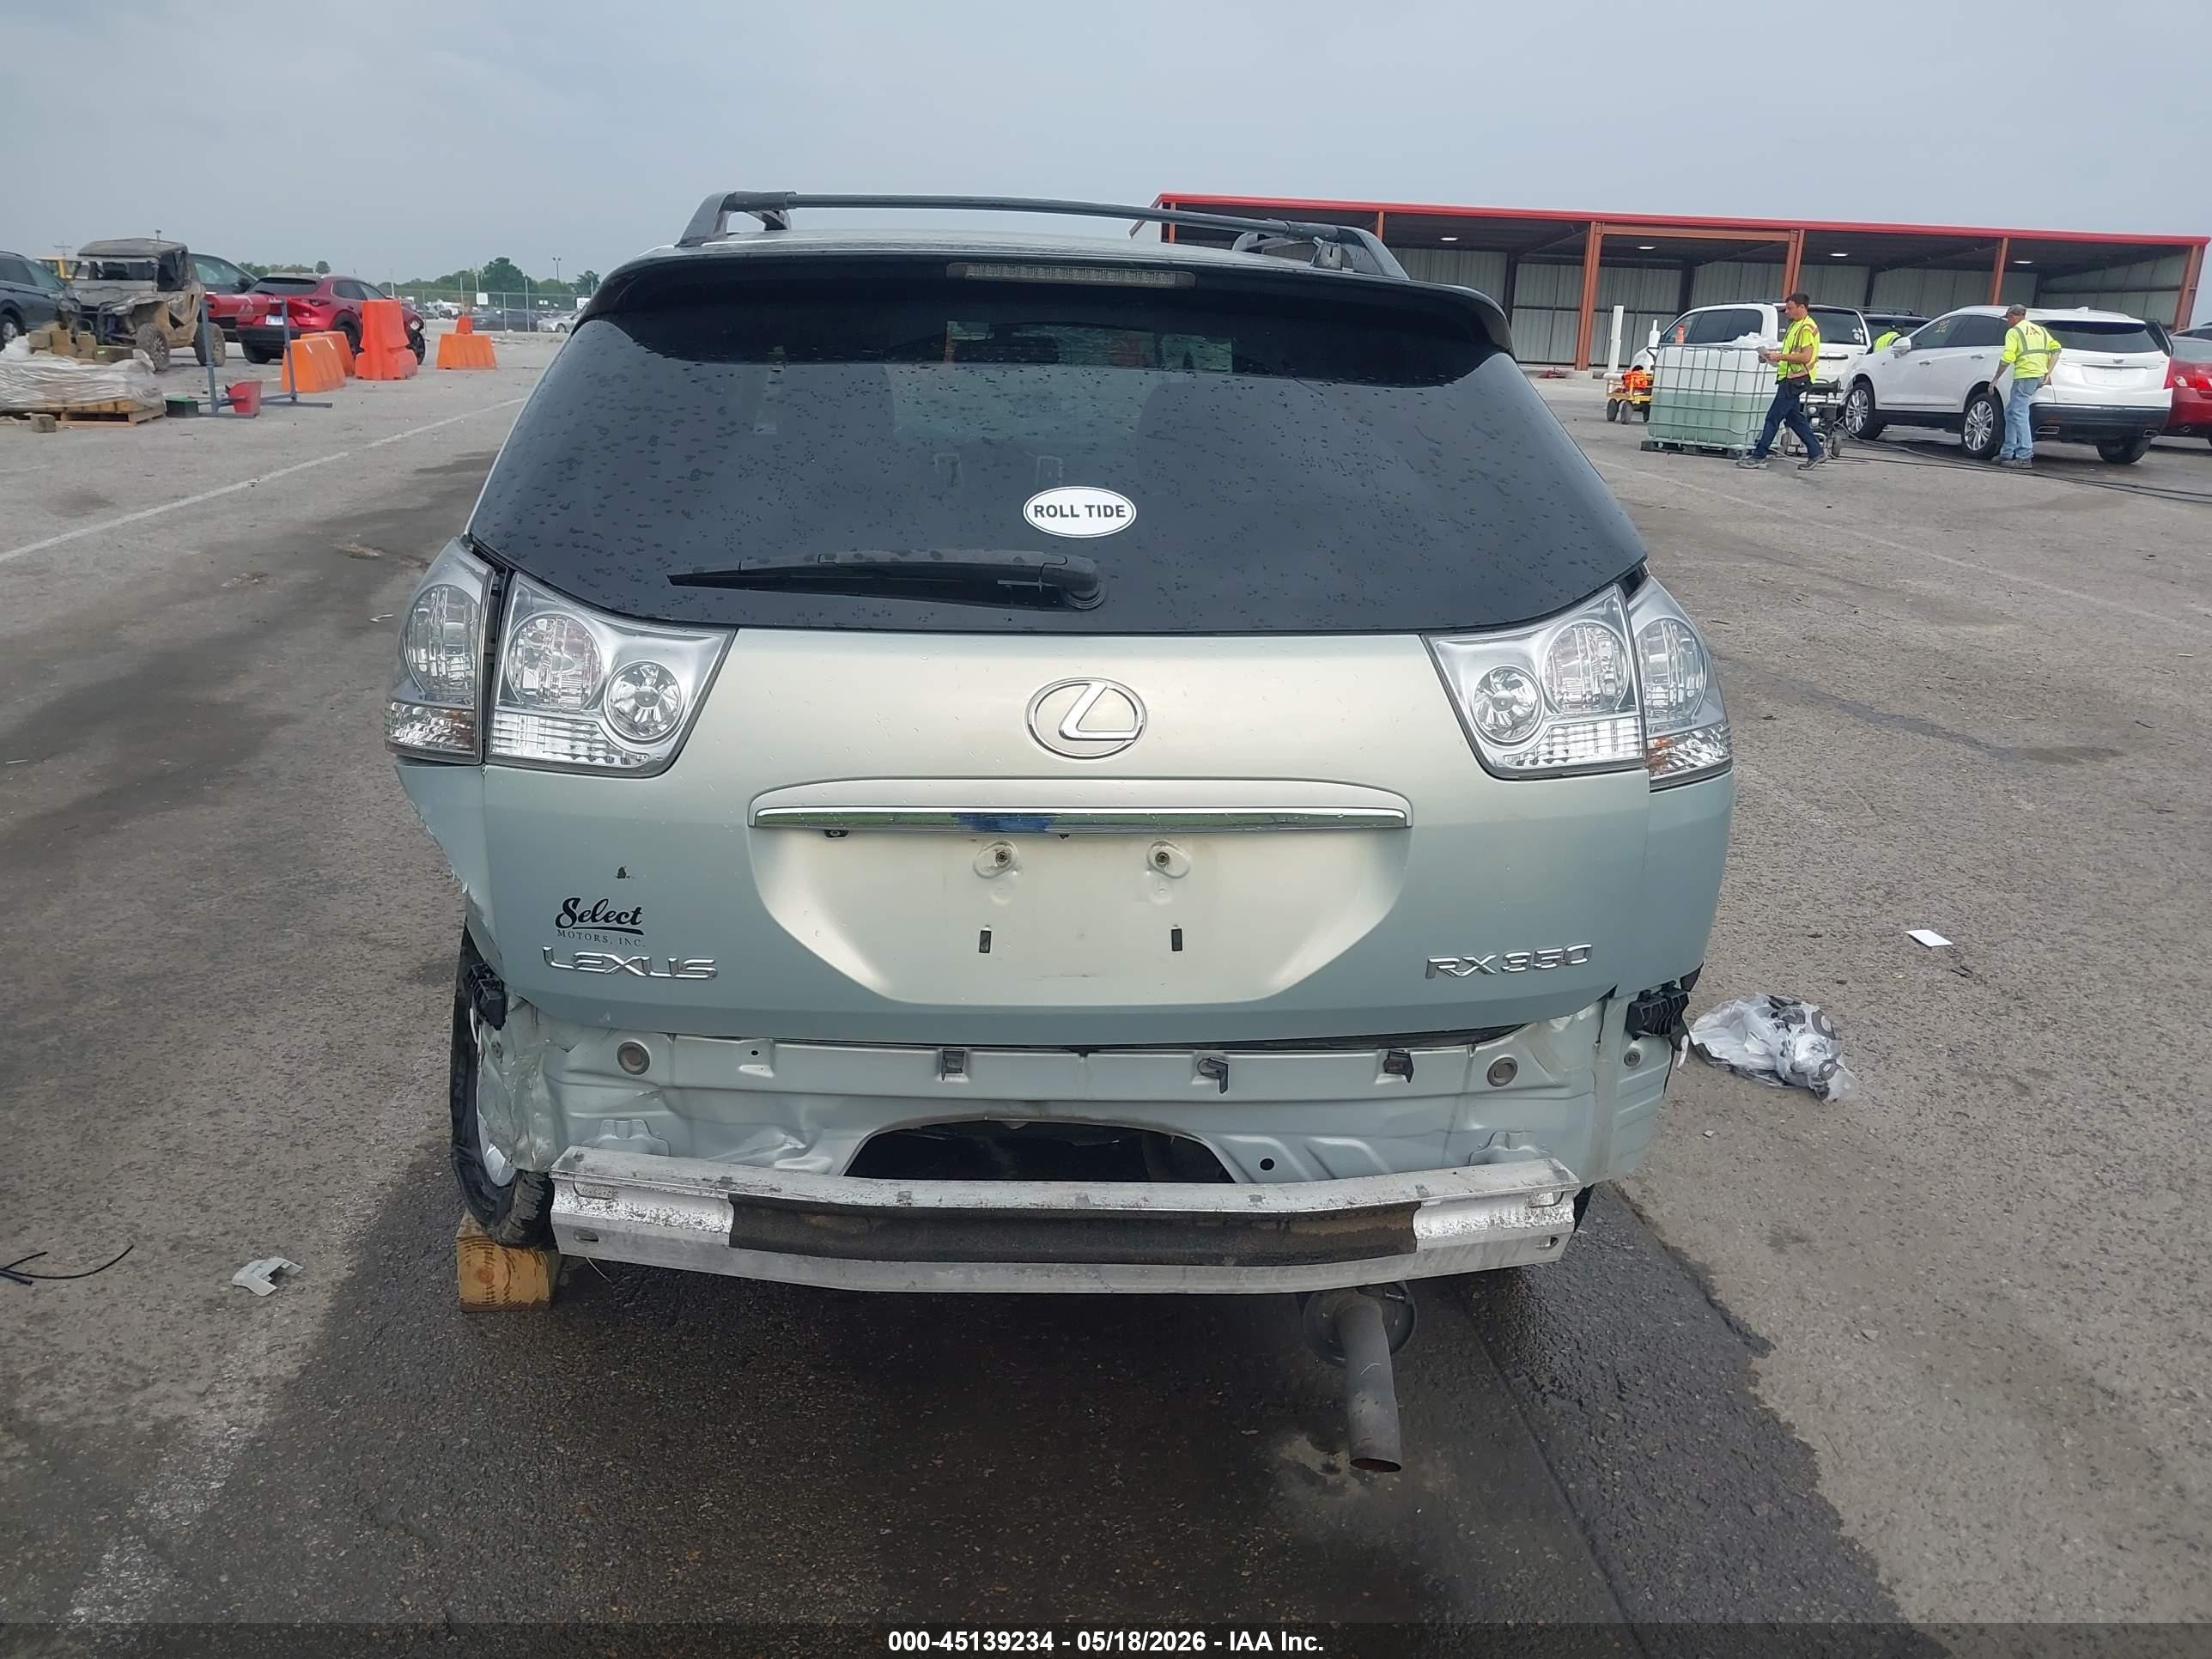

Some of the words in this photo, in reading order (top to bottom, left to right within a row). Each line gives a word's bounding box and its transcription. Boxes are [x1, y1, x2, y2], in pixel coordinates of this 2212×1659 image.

[1034, 504, 1079, 518] ROLL
[1085, 504, 1126, 518] TIDE
[555, 896, 644, 930] Select
[542, 945, 720, 980] LEXUS
